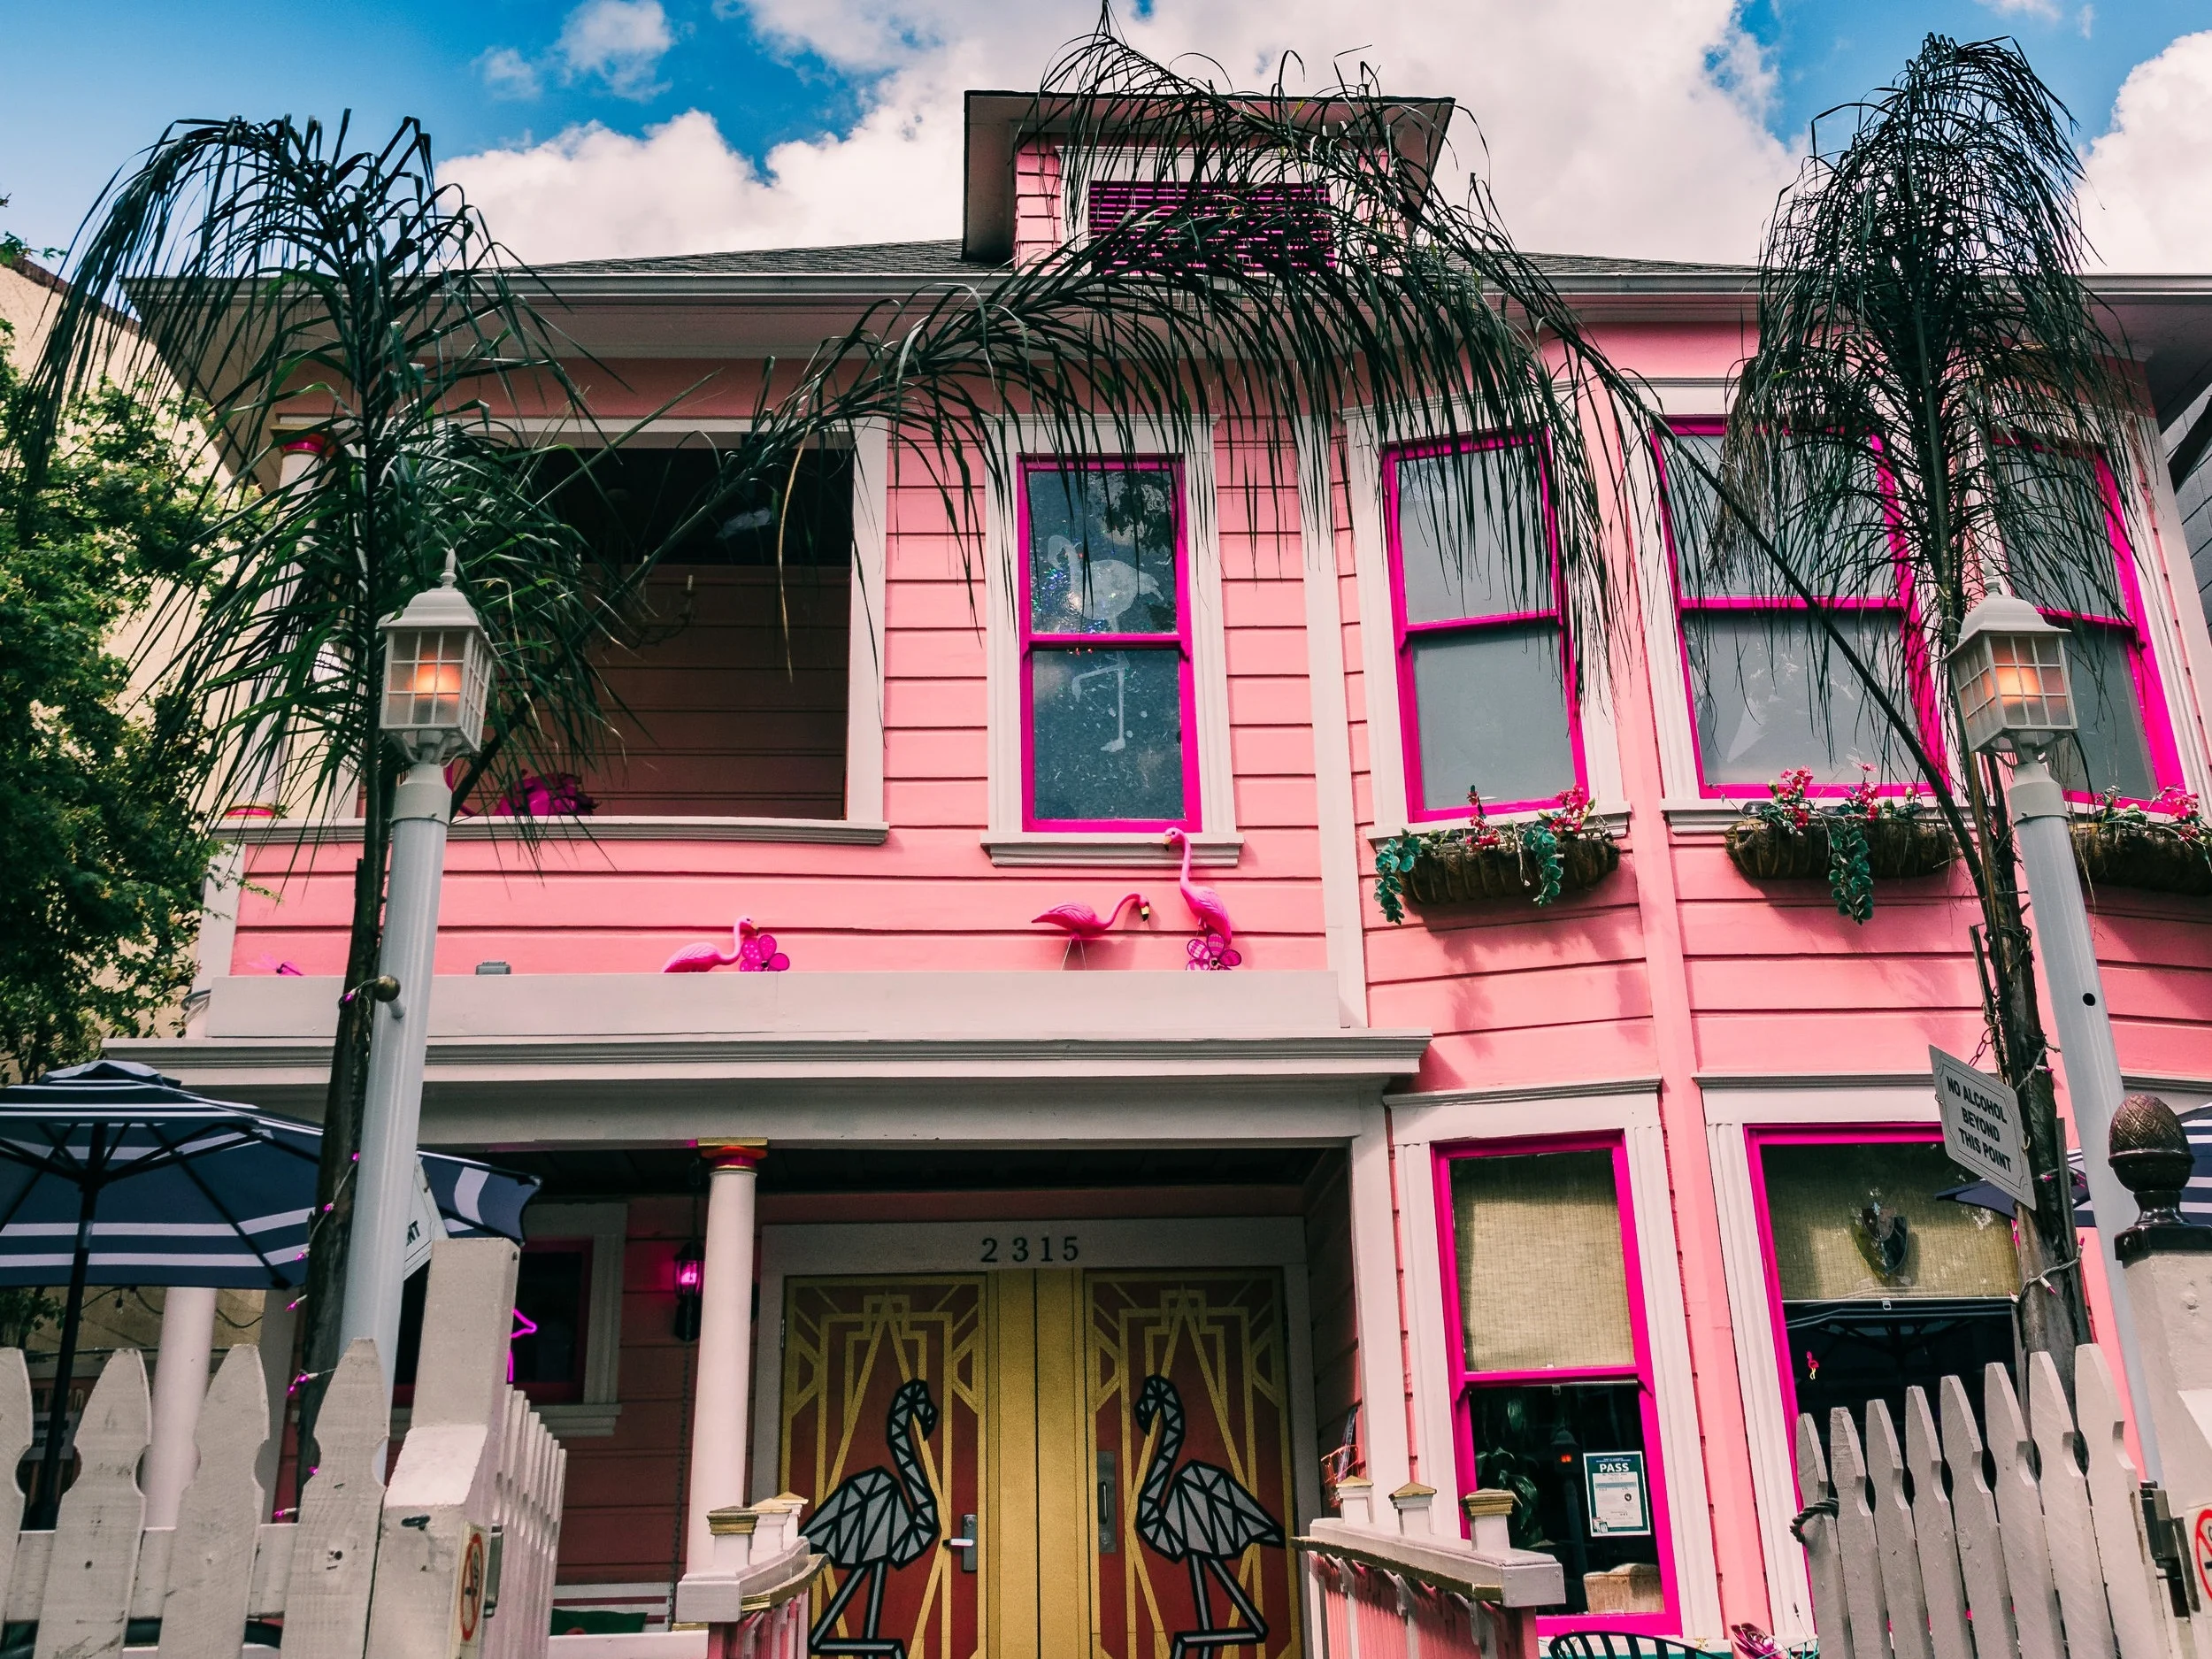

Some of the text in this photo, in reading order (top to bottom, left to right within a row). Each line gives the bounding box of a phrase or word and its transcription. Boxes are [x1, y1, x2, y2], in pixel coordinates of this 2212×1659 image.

[1947, 1075, 2008, 1125] NO ALCOHOL
[1961, 1106, 2001, 1143] BEYOND
[1958, 1126, 2012, 1173] THIS POINT
[980, 1236, 1079, 1263] 2315
[1599, 1463, 1630, 1473] PASS
